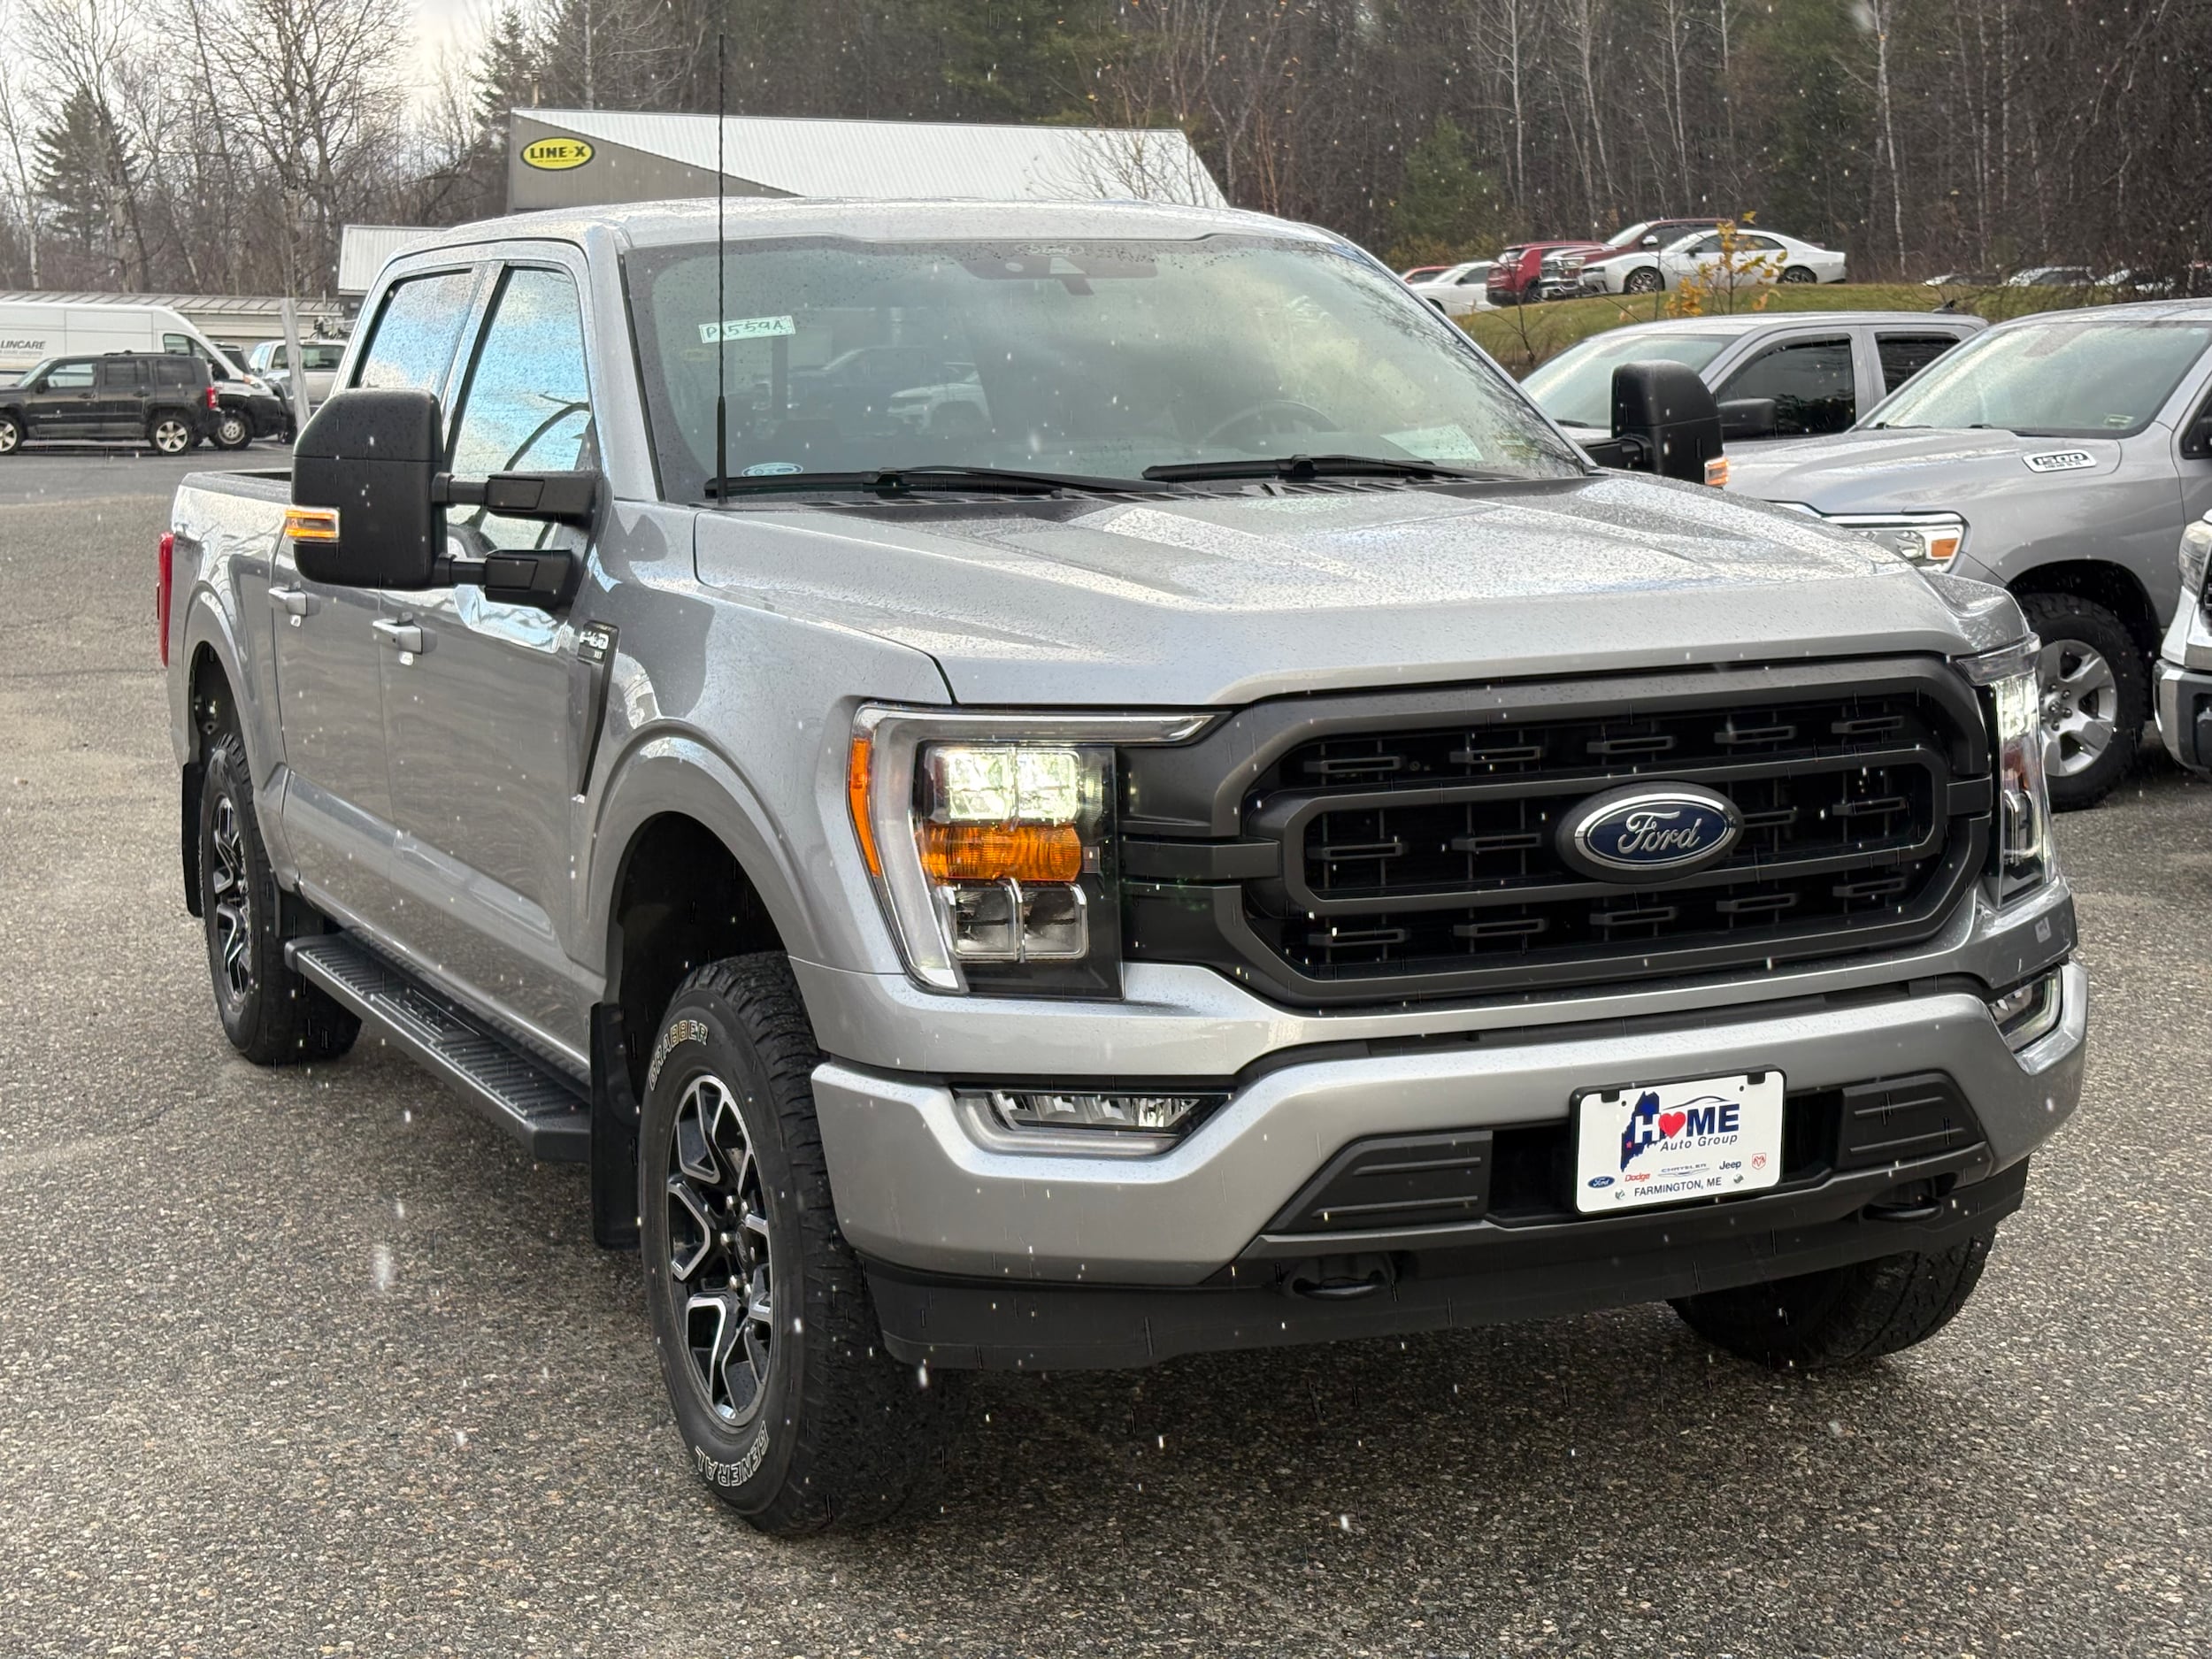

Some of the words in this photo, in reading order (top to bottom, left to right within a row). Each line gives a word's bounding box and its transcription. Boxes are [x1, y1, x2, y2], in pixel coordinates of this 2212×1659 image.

[529, 146, 586, 159] LINE-X
[705, 319, 784, 338] P559A
[1, 340, 46, 349] LINCARE
[1617, 810, 1703, 855] Ford
[649, 1019, 709, 1092] GRABBER
[1660, 1140, 1692, 1152] Auto
[1698, 1134, 1739, 1147] Group
[1661, 1163, 1707, 1173] CHRYSLER
[1719, 1161, 1741, 1171] Jeep
[1592, 1177, 1609, 1187] Ford
[1624, 1172, 1651, 1183] Dodge
[1634, 1179, 1704, 1197] FARMINGTON,
[1706, 1177, 1722, 1187] ME
[695, 1419, 769, 1486] GENERAL
